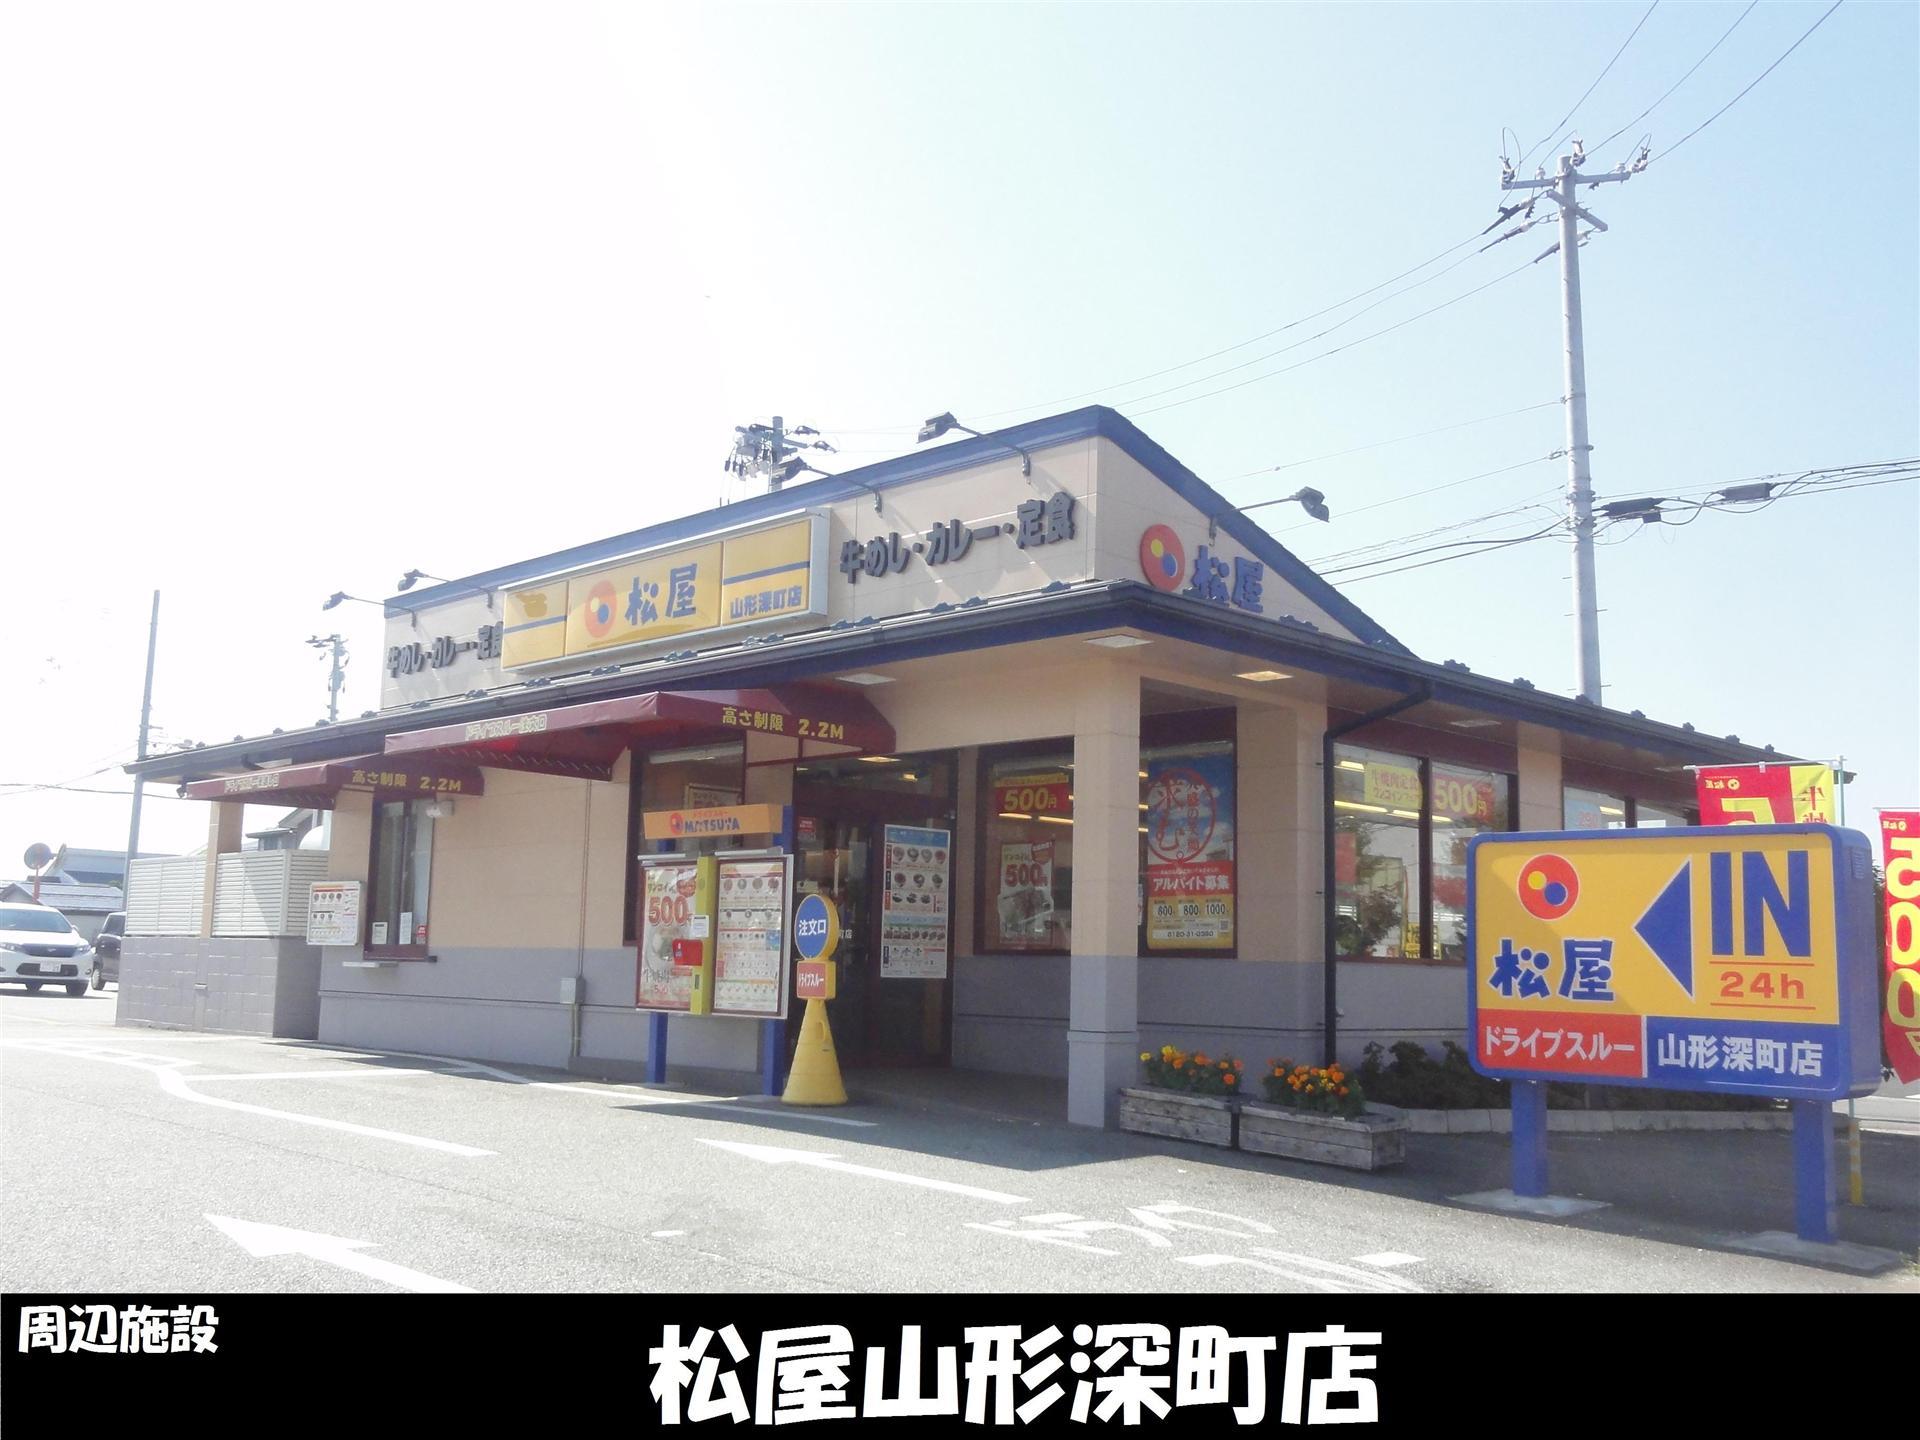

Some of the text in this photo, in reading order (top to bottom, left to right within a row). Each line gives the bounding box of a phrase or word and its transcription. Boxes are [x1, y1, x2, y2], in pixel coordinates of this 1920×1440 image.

[840, 492, 1077, 584] 牛めし・カレー・定食
[625, 563, 698, 626] 松屋
[1191, 545, 1264, 613] 松屋
[730, 585, 803, 619] 山形深町店
[722, 707, 844, 740] 高さ制限 2.2M
[352, 769, 462, 793] 高さ制限 2.2M
[684, 818, 740, 834] MATSUYA
[1710, 850, 1812, 957] IN
[798, 919, 827, 936] 注文口
[1488, 936, 1616, 1001] 松屋
[1719, 970, 1806, 1000] 24h
[1485, 1025, 1636, 1061] ドライブスルー
[1657, 1033, 1823, 1078] 山形深町店
